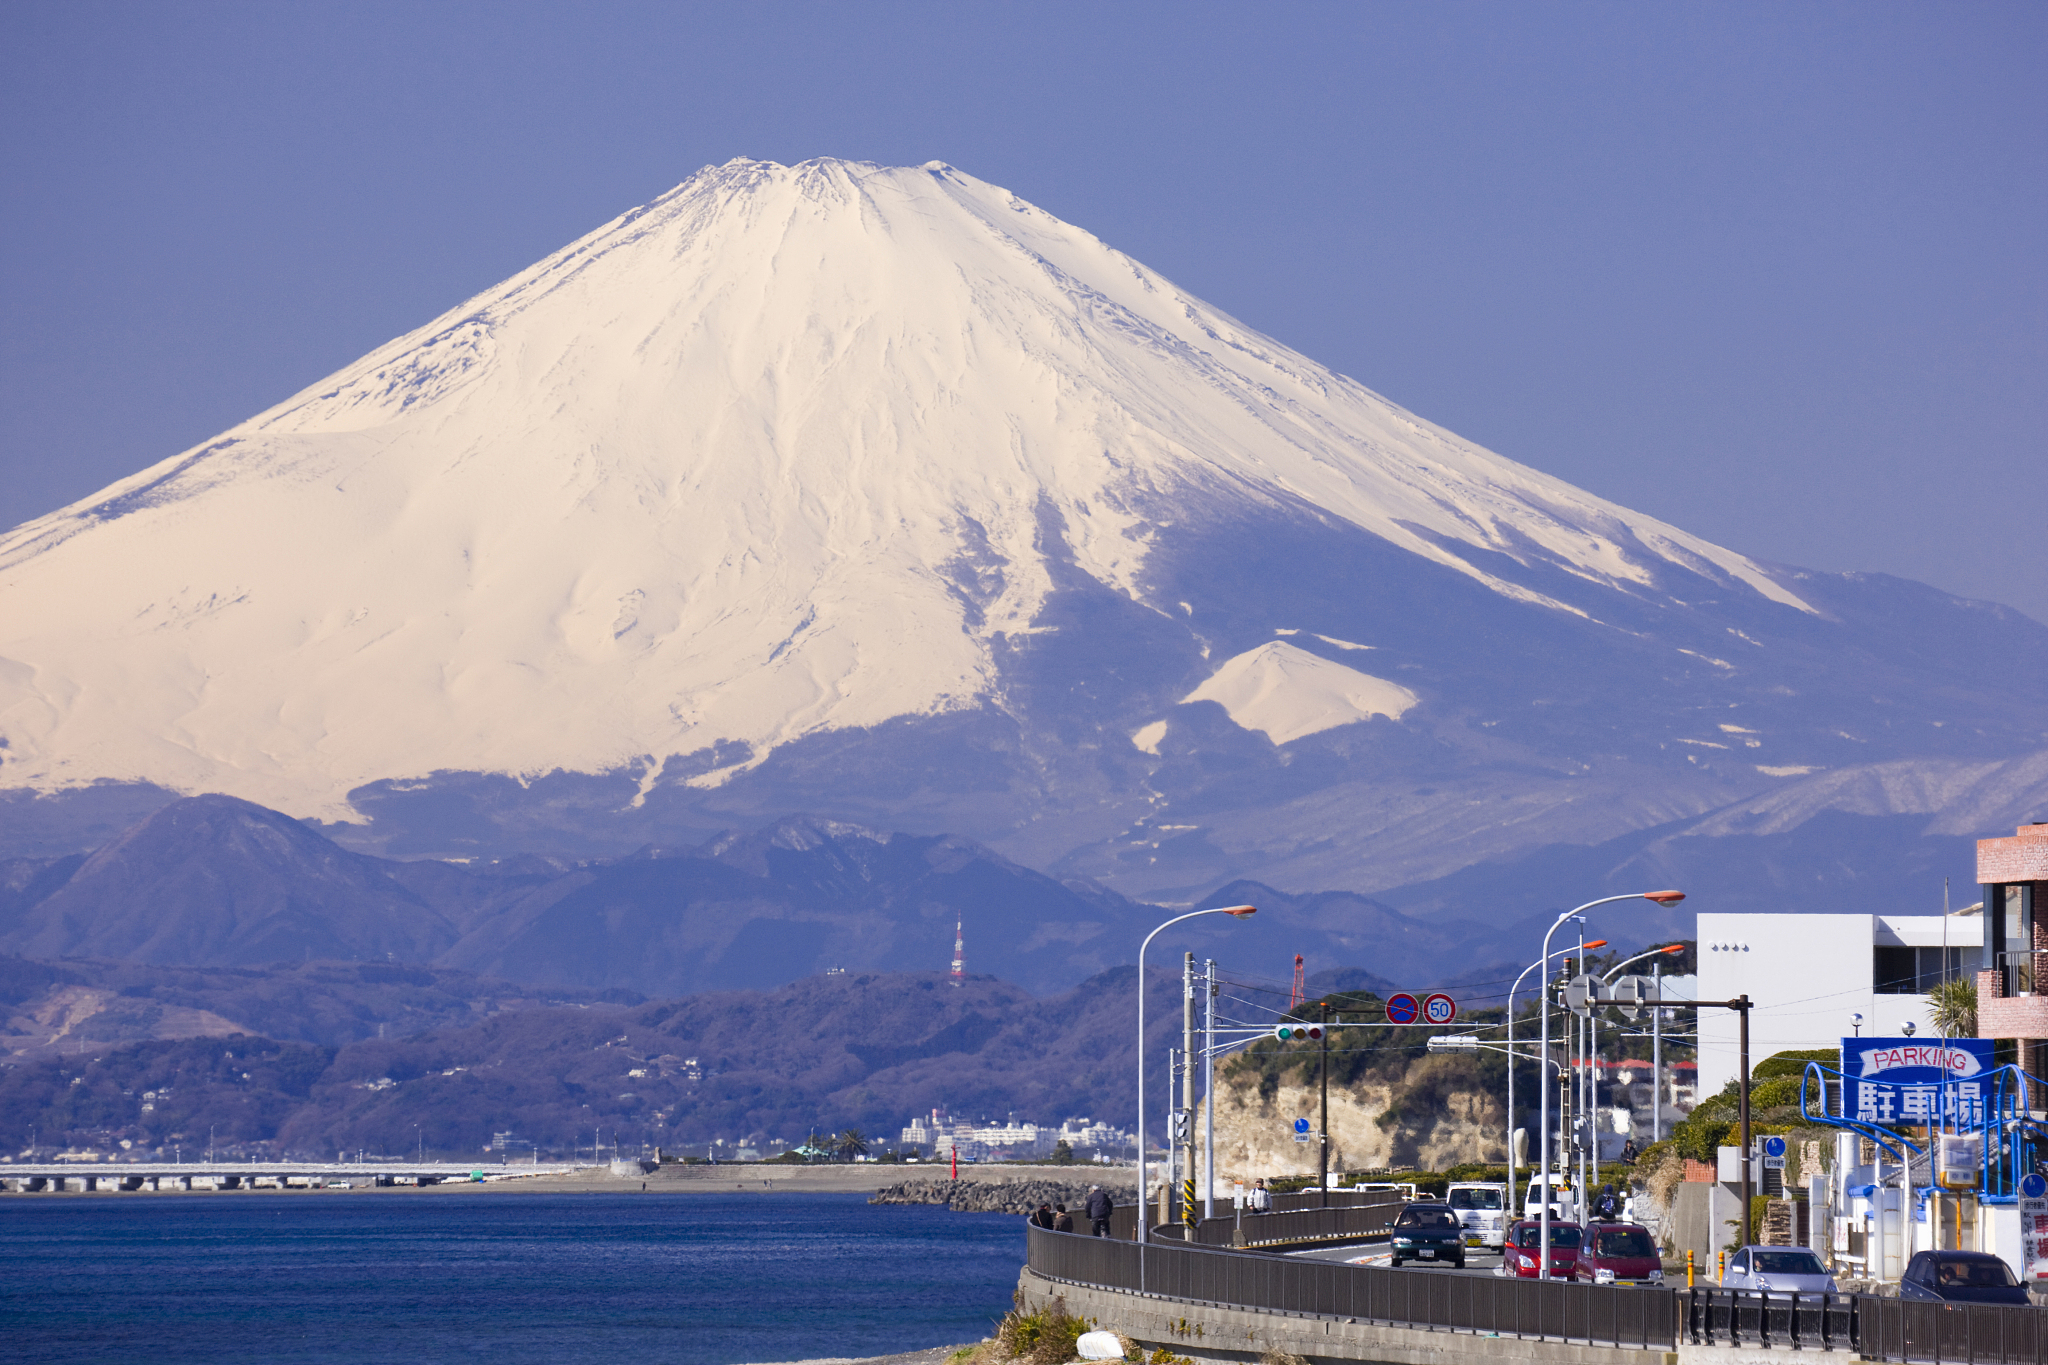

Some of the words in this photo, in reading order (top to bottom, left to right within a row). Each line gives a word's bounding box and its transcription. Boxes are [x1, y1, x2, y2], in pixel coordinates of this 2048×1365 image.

[1430, 1002, 1449, 1018] 50
[1873, 1047, 1967, 1071] PARKING
[1856, 1081, 1983, 1124] 駐車場
